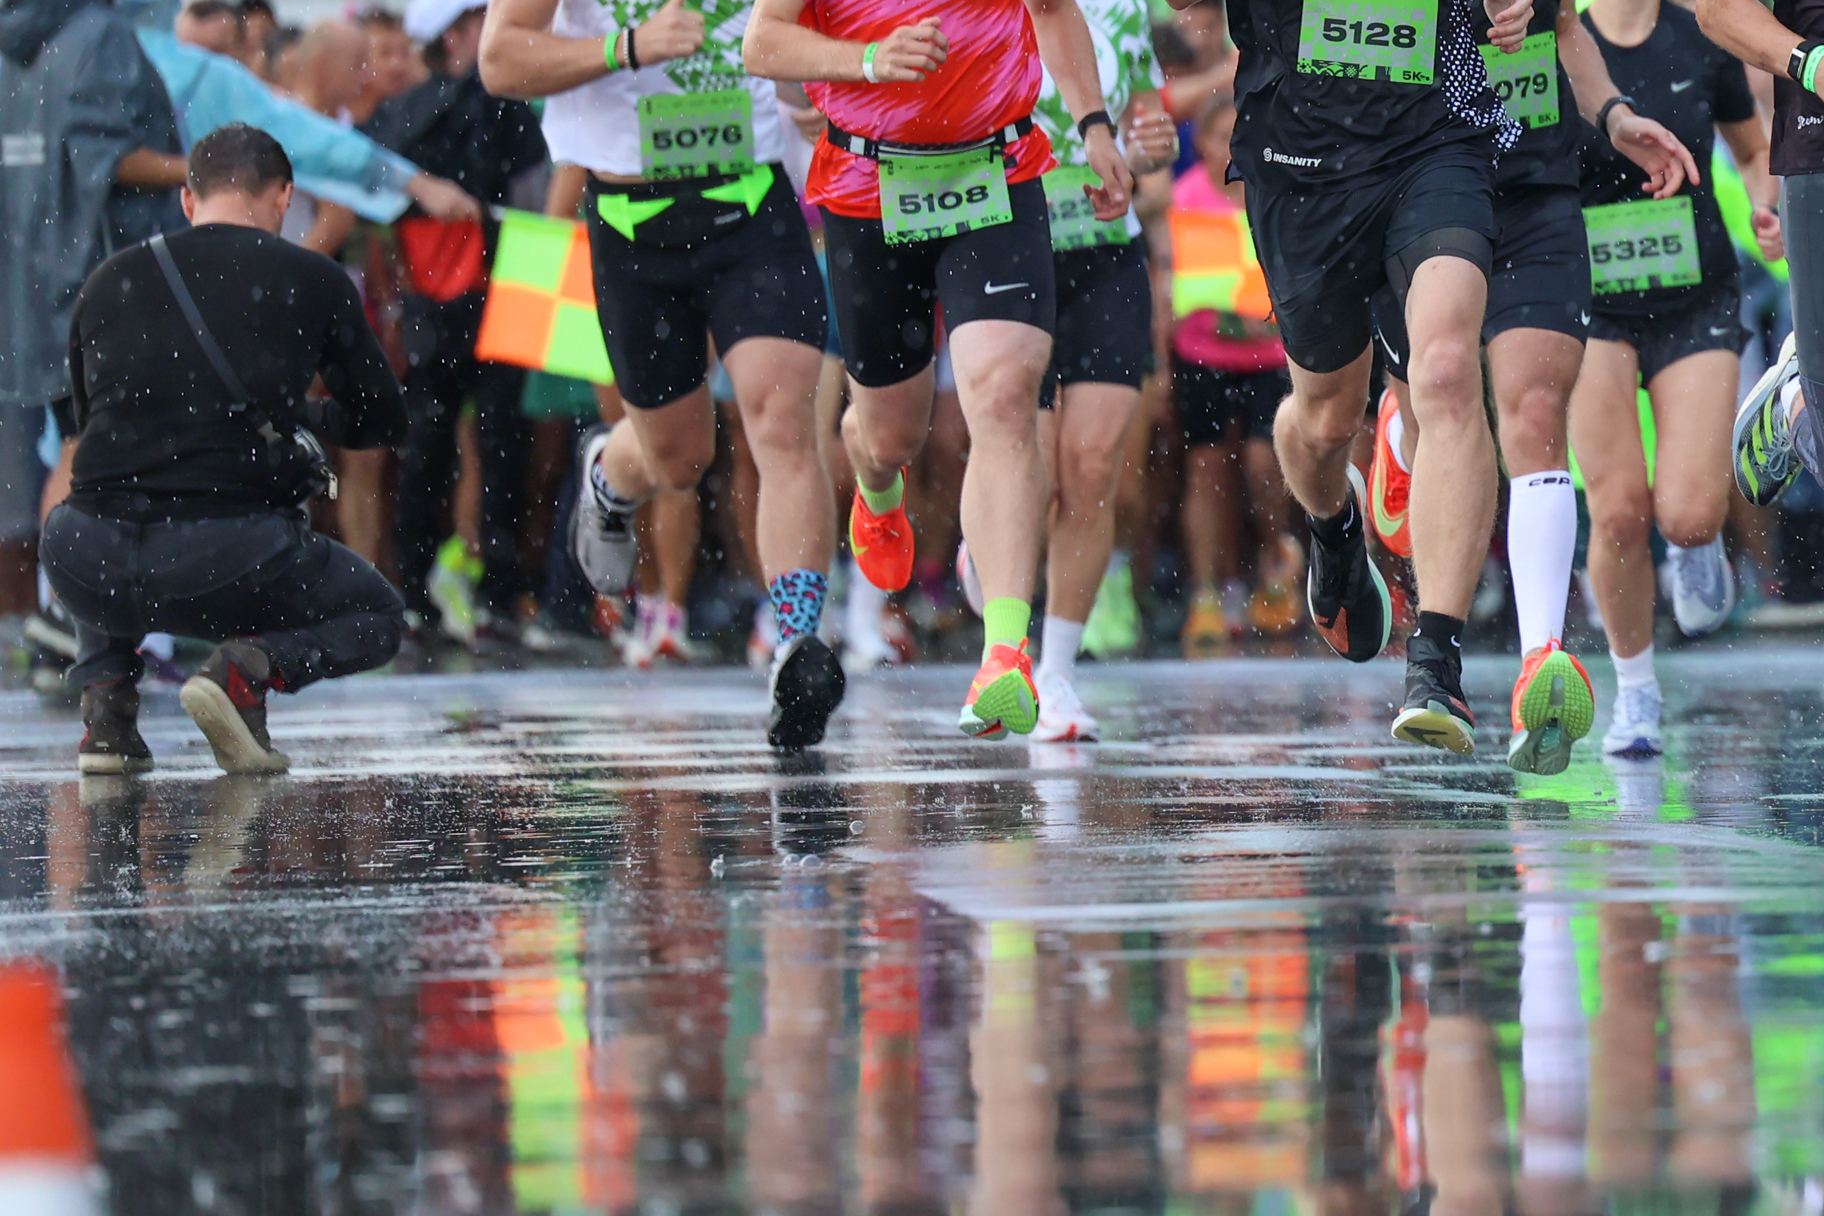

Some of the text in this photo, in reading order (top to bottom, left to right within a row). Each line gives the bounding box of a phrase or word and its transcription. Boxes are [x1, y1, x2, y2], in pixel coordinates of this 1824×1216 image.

[1322, 18, 1417, 49] 5128
[1402, 70, 1422, 82] 5K
[1493, 72, 1548, 102] 079
[653, 124, 743, 151] 5076
[1273, 153, 1322, 167] INSANITY
[899, 185, 990, 215] 5108
[981, 215, 1000, 225] 5K
[1592, 234, 1683, 264] 5325
